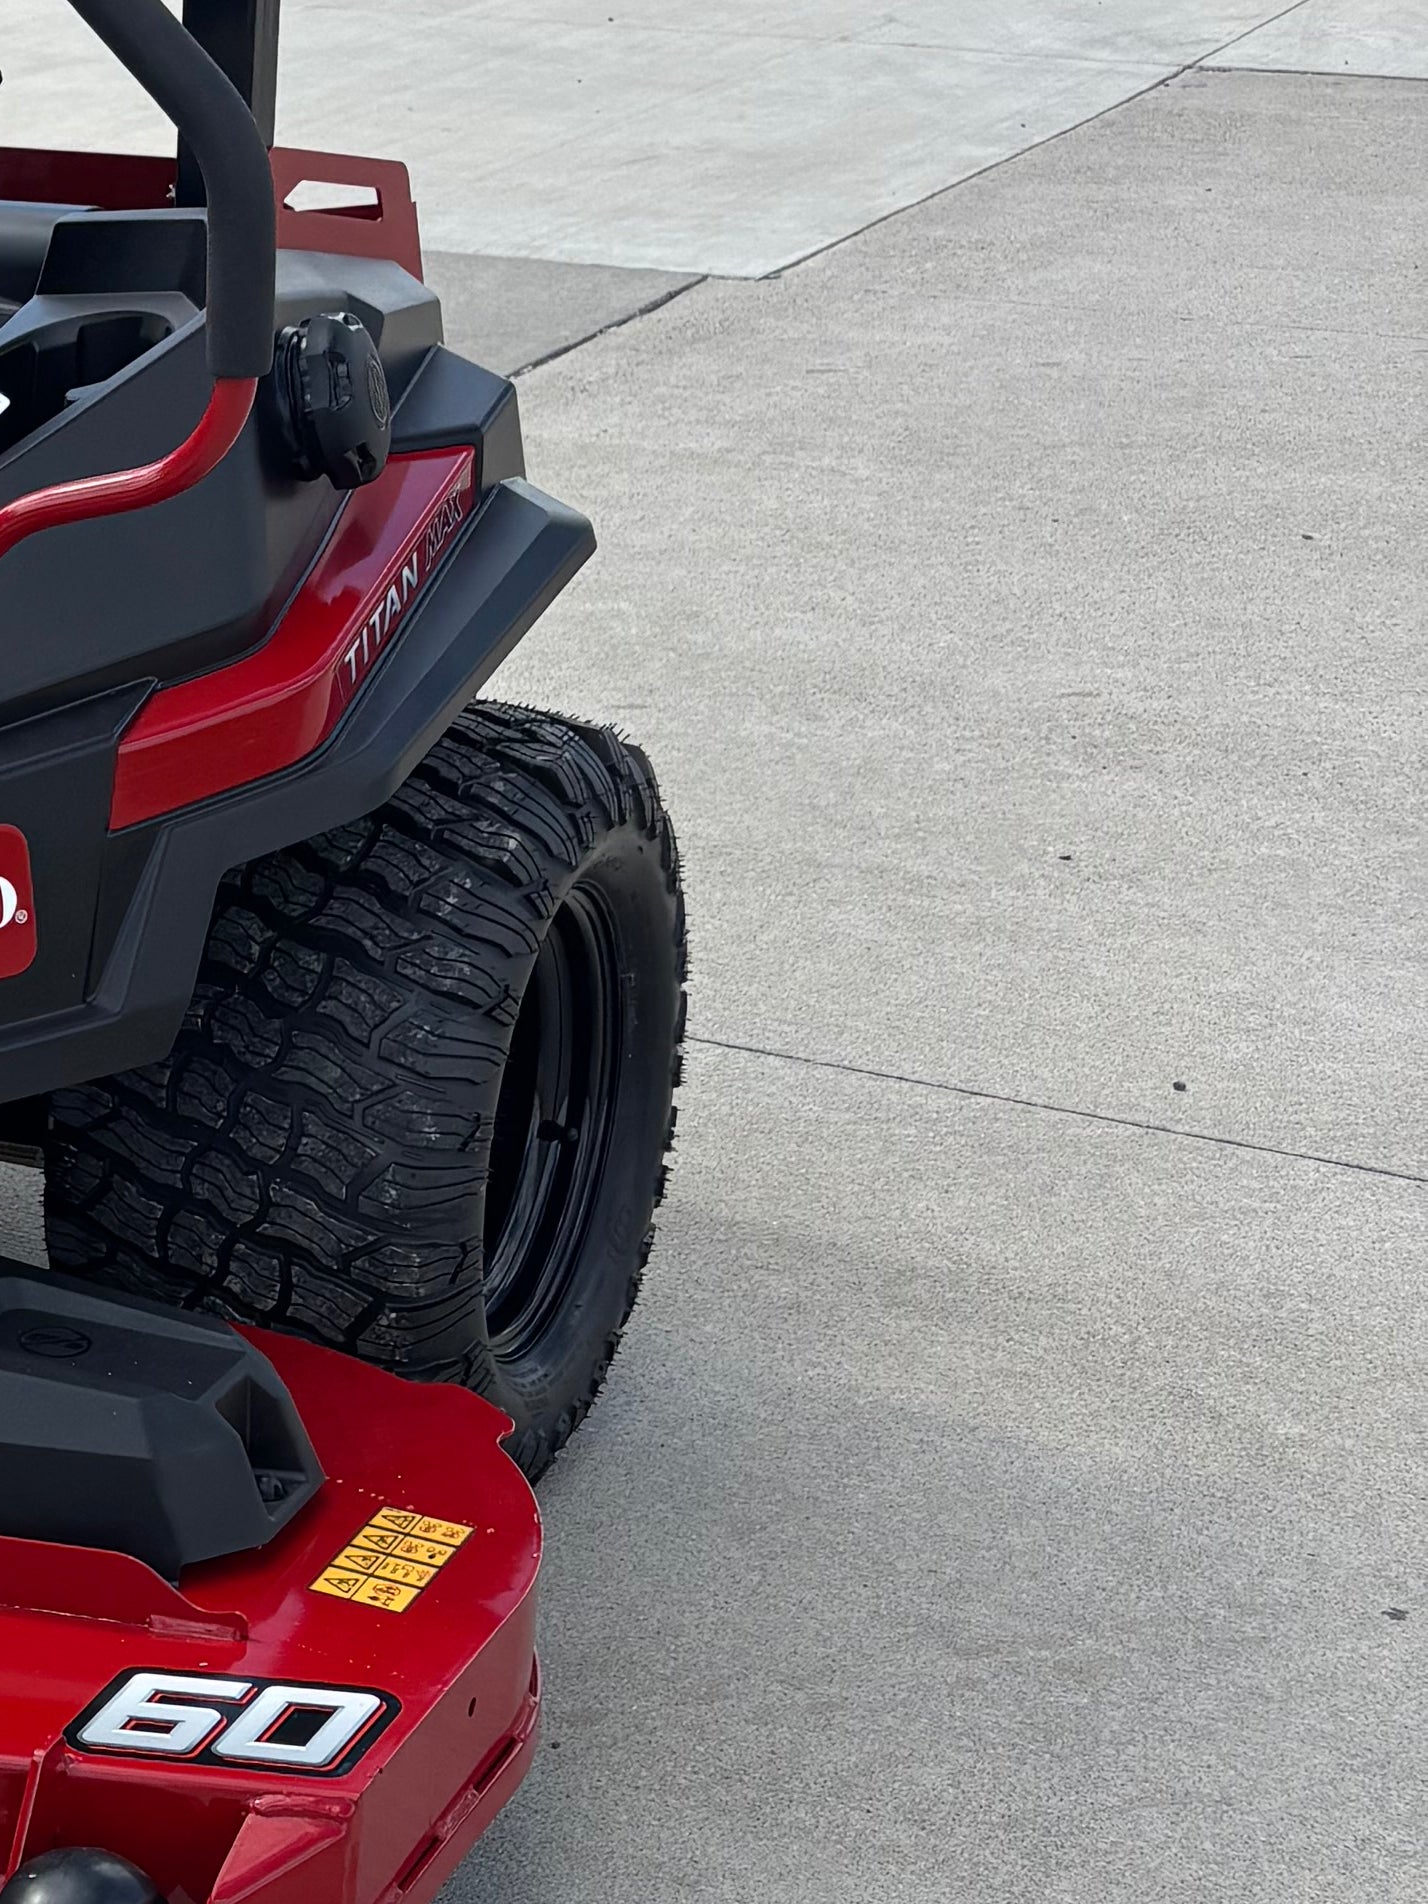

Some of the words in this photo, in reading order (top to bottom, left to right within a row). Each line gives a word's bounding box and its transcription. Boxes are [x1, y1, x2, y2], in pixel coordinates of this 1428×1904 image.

[345, 552, 418, 684] TITAN
[425, 483, 464, 572] MAX
[76, 1673, 386, 1770] 60
